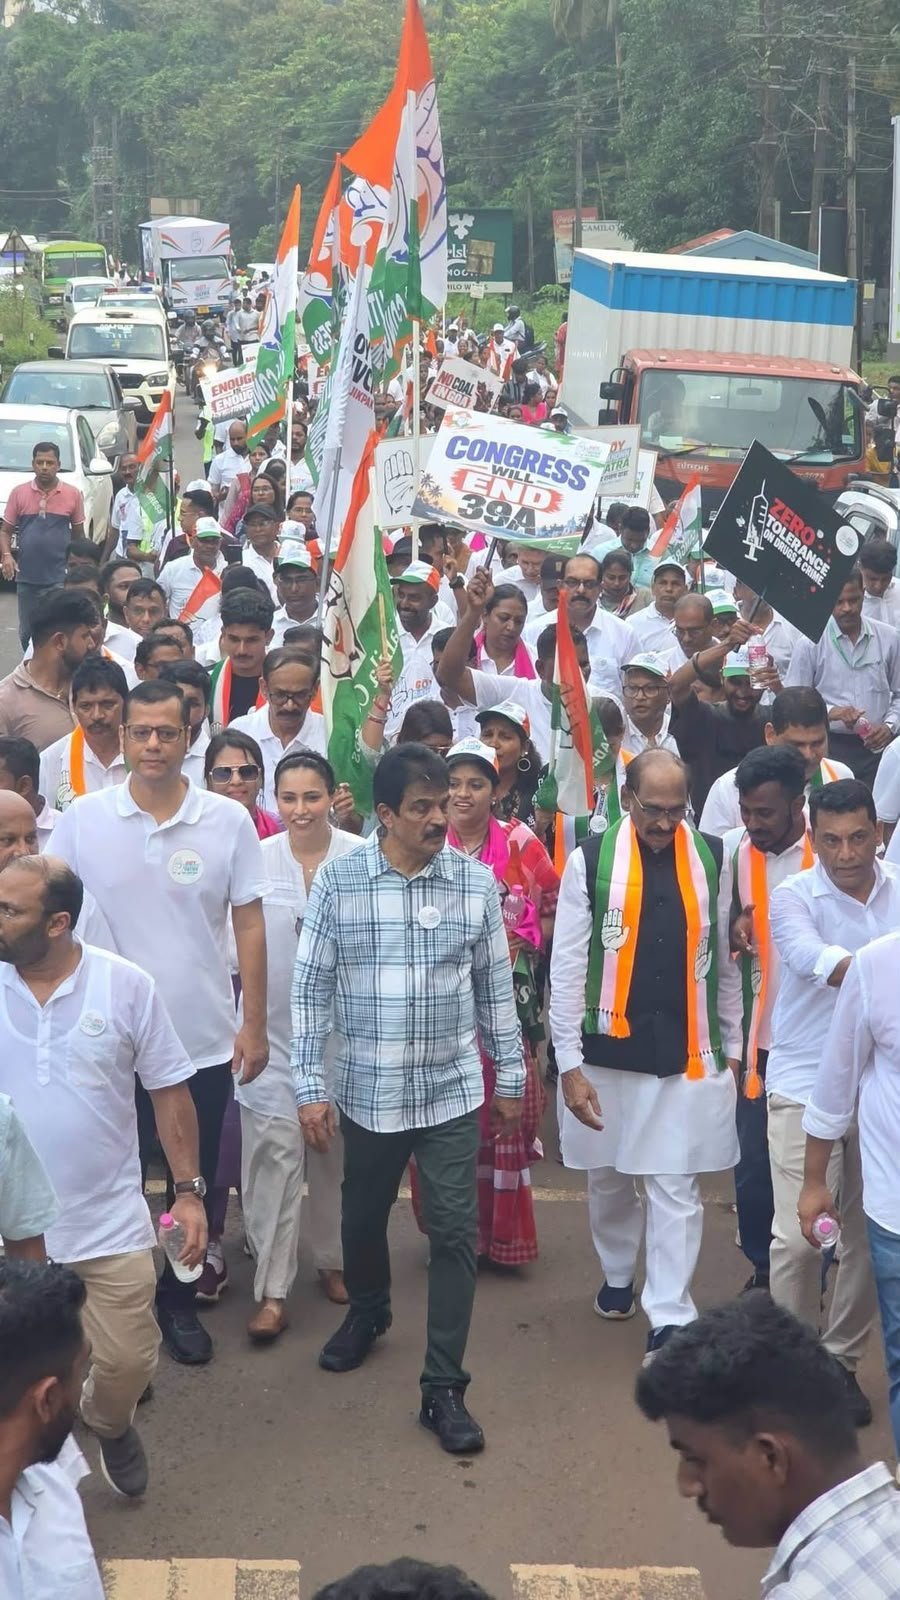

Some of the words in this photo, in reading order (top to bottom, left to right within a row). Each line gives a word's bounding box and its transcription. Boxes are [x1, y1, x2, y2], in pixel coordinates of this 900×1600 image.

[434, 385, 449, 399] IN
[447, 390, 469, 408] GOA
[437, 371, 454, 386] NO
[452, 377, 474, 397] COAL
[445, 435, 590, 491] CONGRESS
[491, 465, 533, 484] WILL
[461, 470, 552, 510] END
[457, 494, 536, 536] 39A
[768, 498, 816, 546] ZERO
[763, 528, 776, 544] ON
[773, 537, 798, 563] DRUGS
[794, 556, 803, 568] &
[800, 561, 825, 588] CRIME.
[766, 514, 829, 577] TOLERANCE
